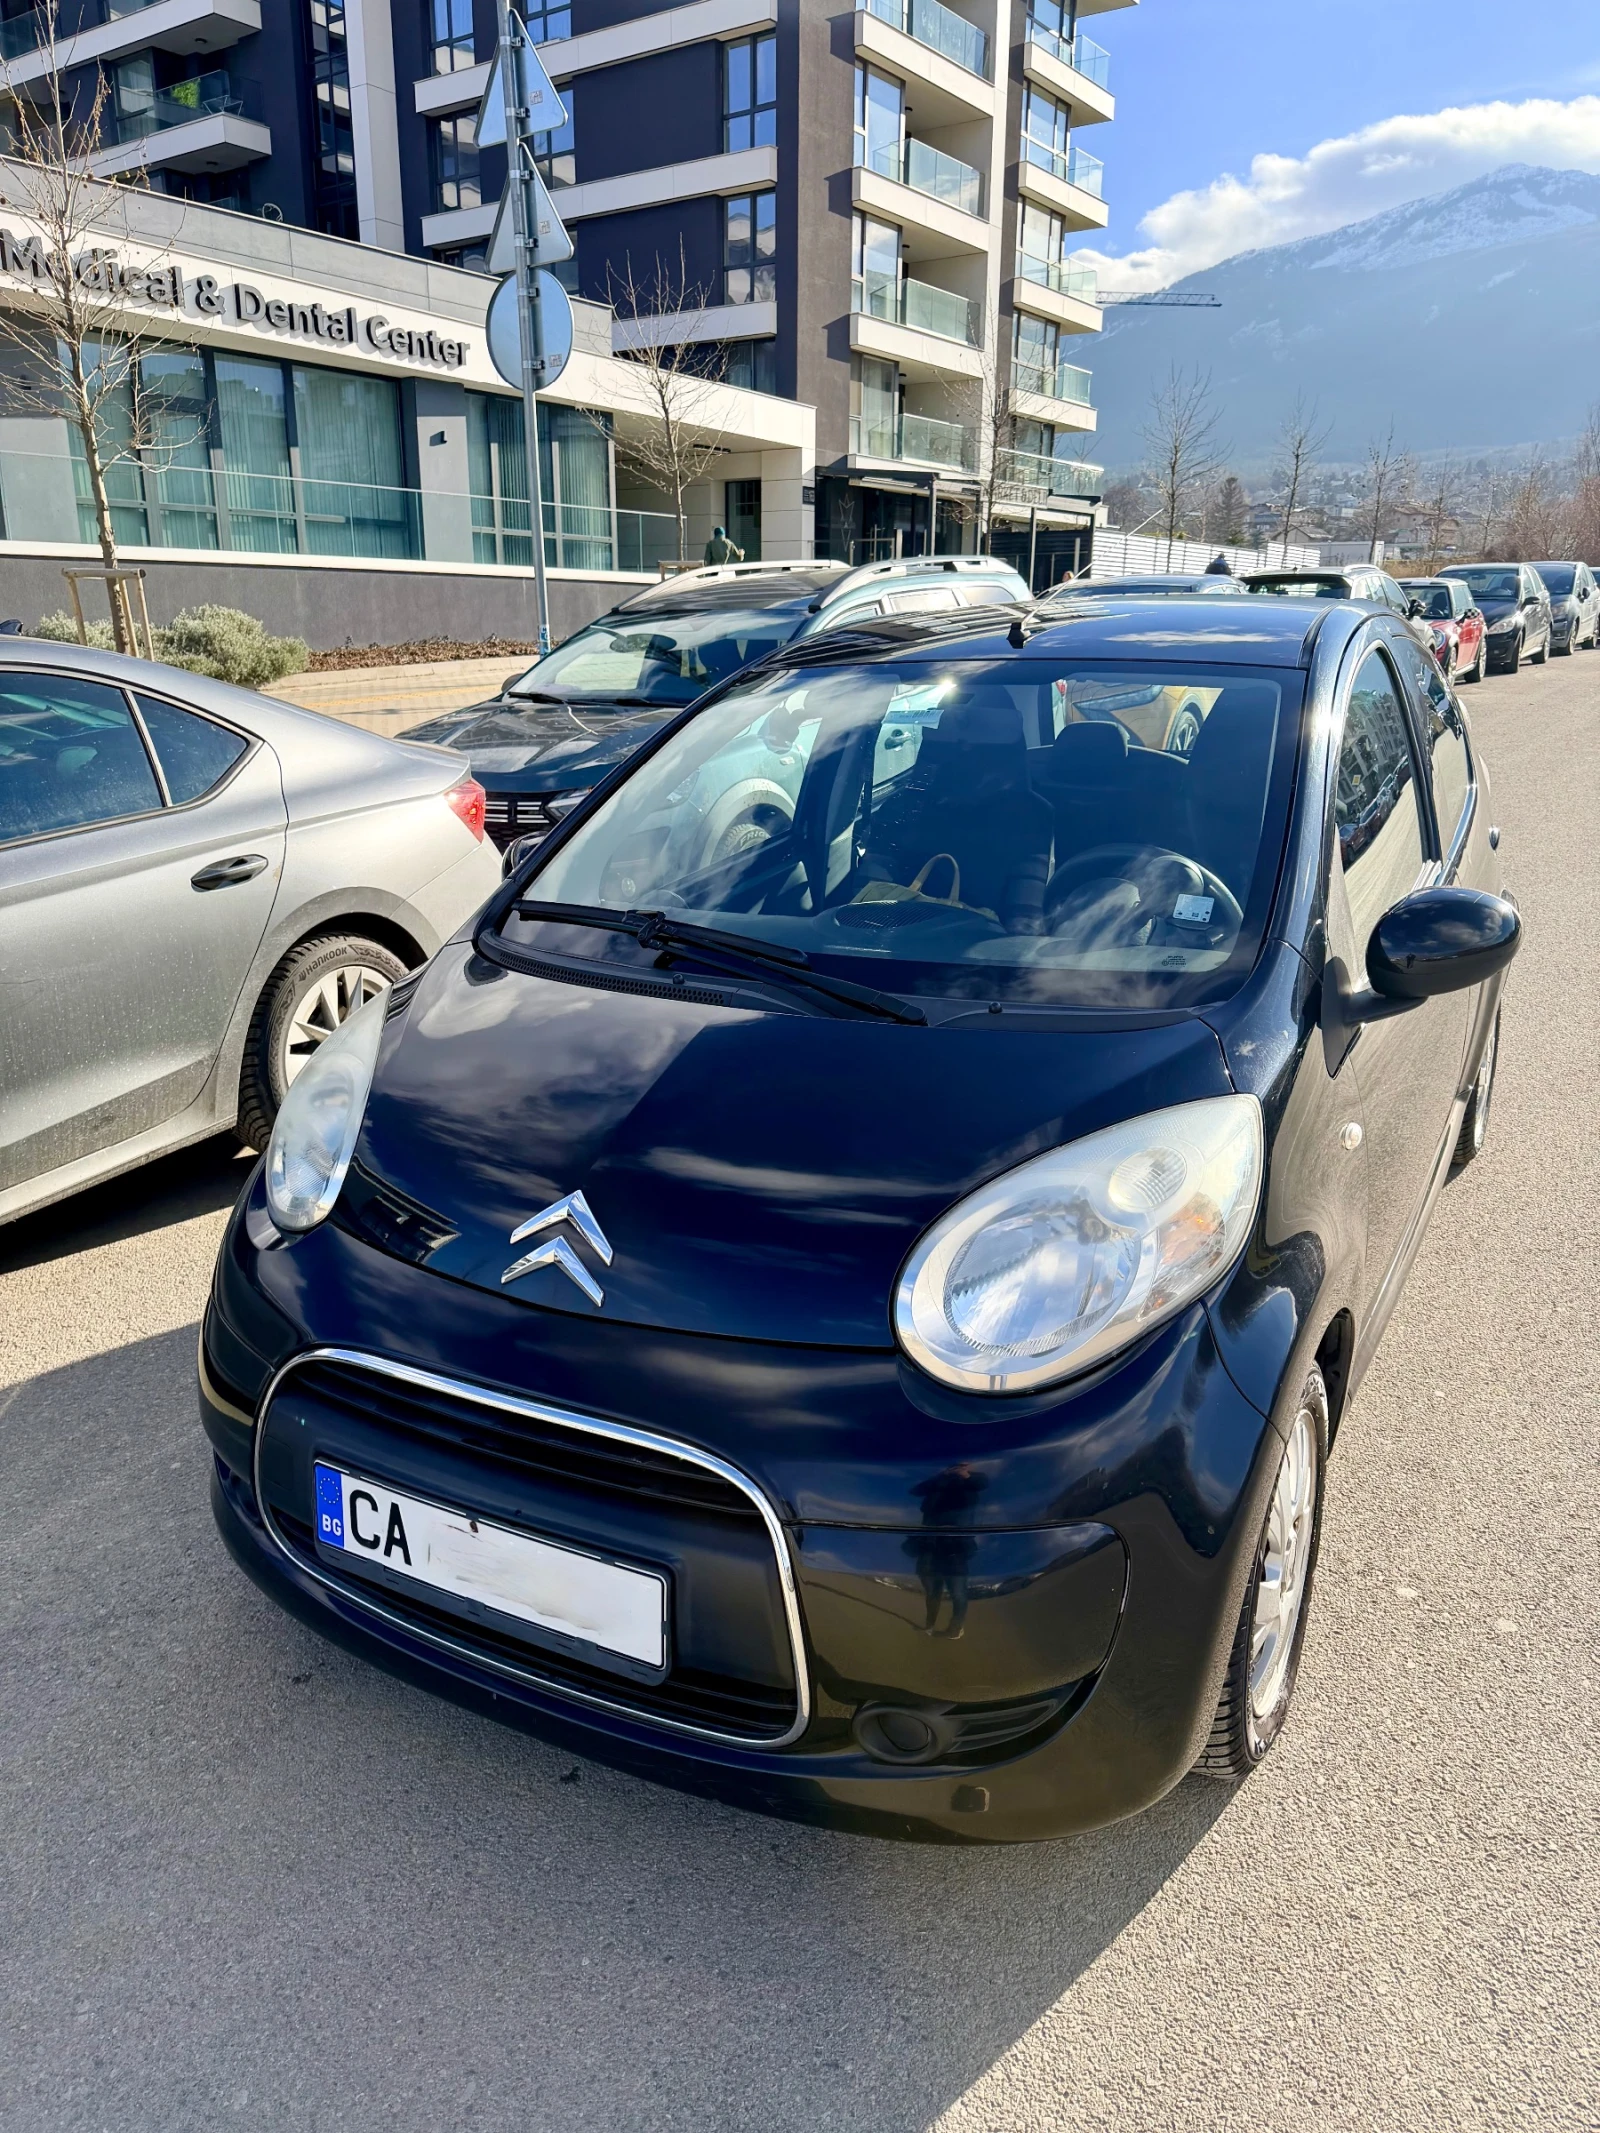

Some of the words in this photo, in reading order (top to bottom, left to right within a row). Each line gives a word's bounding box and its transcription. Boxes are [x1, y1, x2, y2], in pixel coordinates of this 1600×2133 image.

[0, 227, 185, 306] Medical
[196, 274, 226, 316] &
[235, 283, 358, 344] Dental
[366, 315, 471, 366] Center
[740, 830, 770, 847] FRIG
[322, 1514, 342, 1536] BG
[349, 1489, 412, 1566] CA
